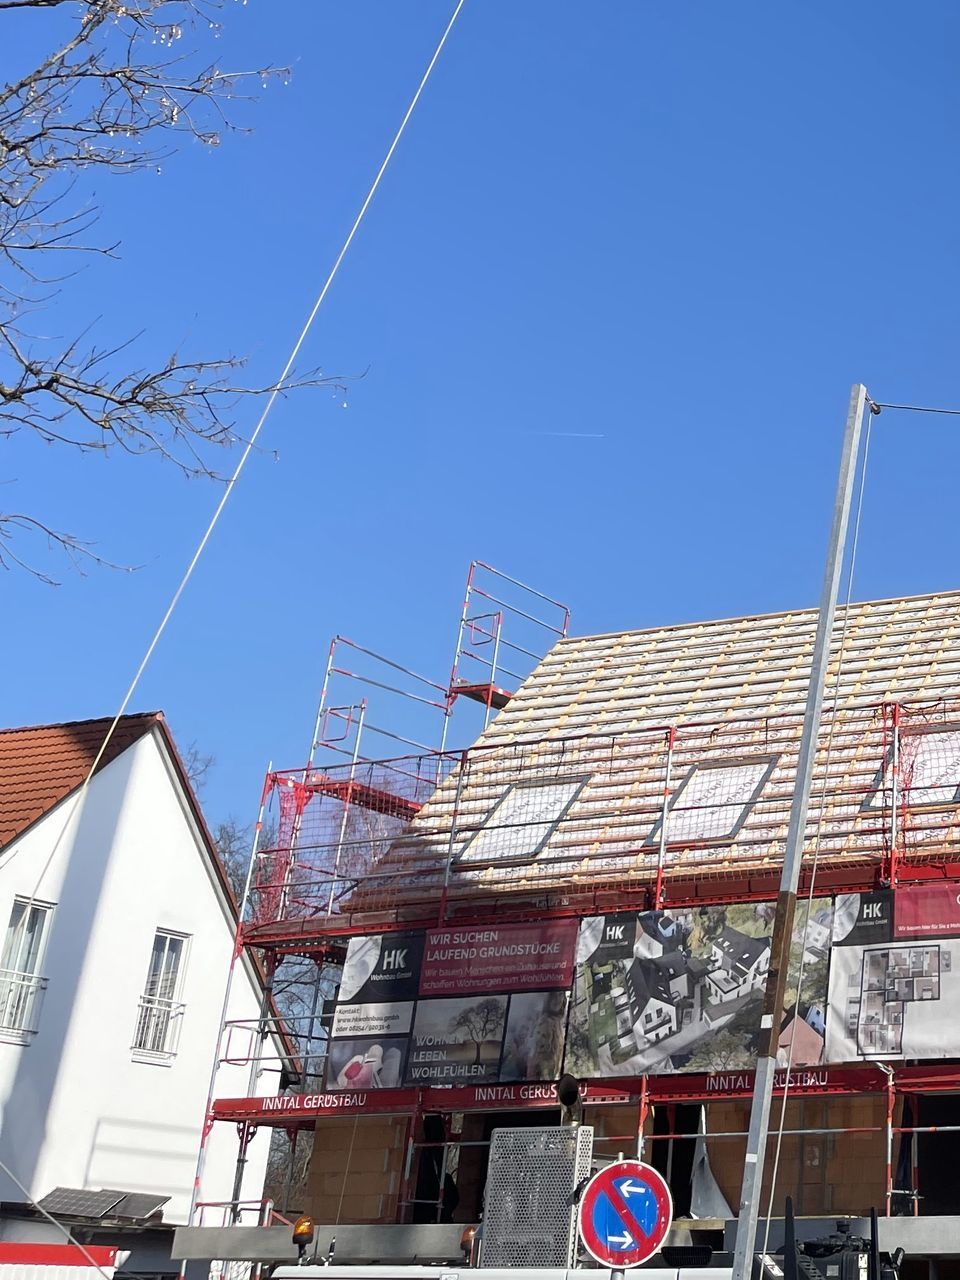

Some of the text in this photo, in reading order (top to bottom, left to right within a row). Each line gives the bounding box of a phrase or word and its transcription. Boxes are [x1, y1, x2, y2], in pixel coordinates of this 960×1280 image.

[863, 902, 883, 919] HK
[429, 930, 499, 945] WIR SUCHEN
[606, 924, 625, 941] HK
[382, 947, 408, 970] HK
[426, 942, 561, 962] LAUFEND GRUNDSTÜCKE
[412, 1050, 447, 1063] LEBEN
[411, 1063, 486, 1078] WOHLFÜHLEN
[706, 1074, 751, 1091] INNTAL
[262, 1092, 367, 1110] INNTAL GERÜSTBAU
[475, 1086, 517, 1101] INNTAL
